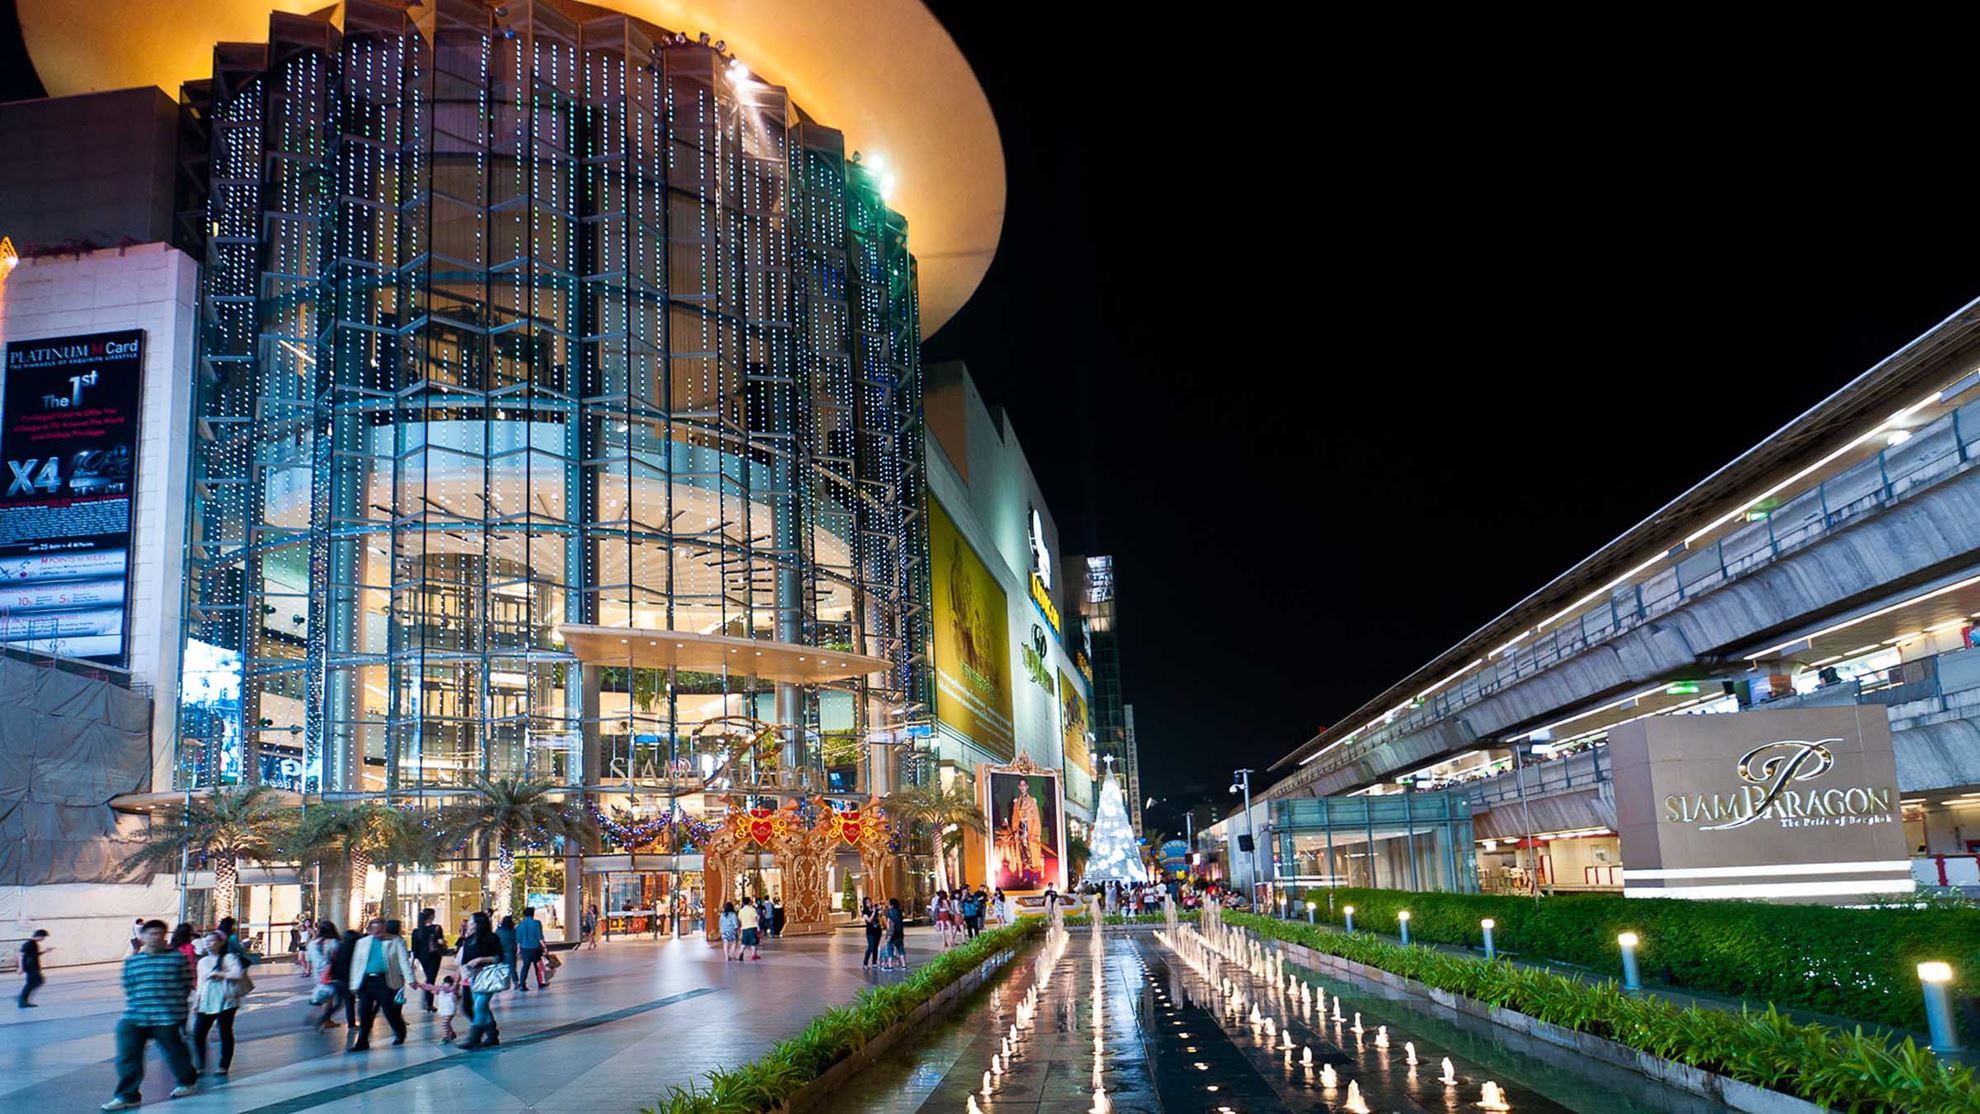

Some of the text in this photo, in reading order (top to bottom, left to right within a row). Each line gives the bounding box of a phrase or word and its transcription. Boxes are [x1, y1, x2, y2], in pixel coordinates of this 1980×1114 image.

[10, 340, 138, 364] PLATINUM M Card
[42, 369, 99, 409] The 1st
[6, 456, 62, 496] X4
[610, 757, 690, 787] SIAM
[1664, 785, 1889, 823] SIAM PARAGON
[1780, 818, 1800, 828] The
[1803, 816, 1830, 827] Pride
[1834, 815, 1846, 827] of
